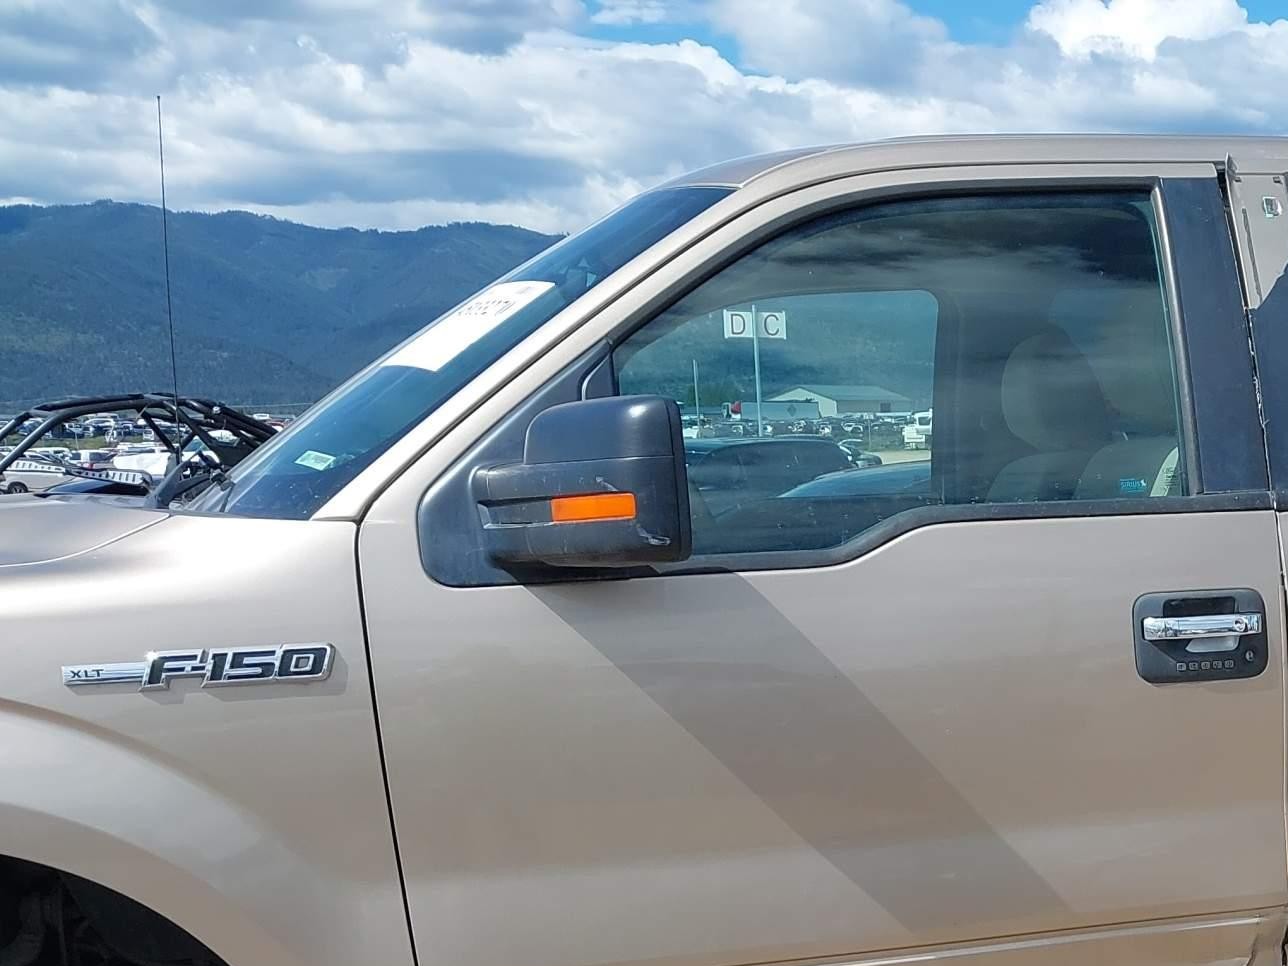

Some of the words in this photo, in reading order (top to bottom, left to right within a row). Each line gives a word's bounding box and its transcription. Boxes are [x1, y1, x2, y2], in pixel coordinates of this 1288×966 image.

[731, 313, 746, 335] D
[764, 314, 779, 336] C
[70, 669, 104, 679] XLT
[138, 642, 338, 692] F-150
